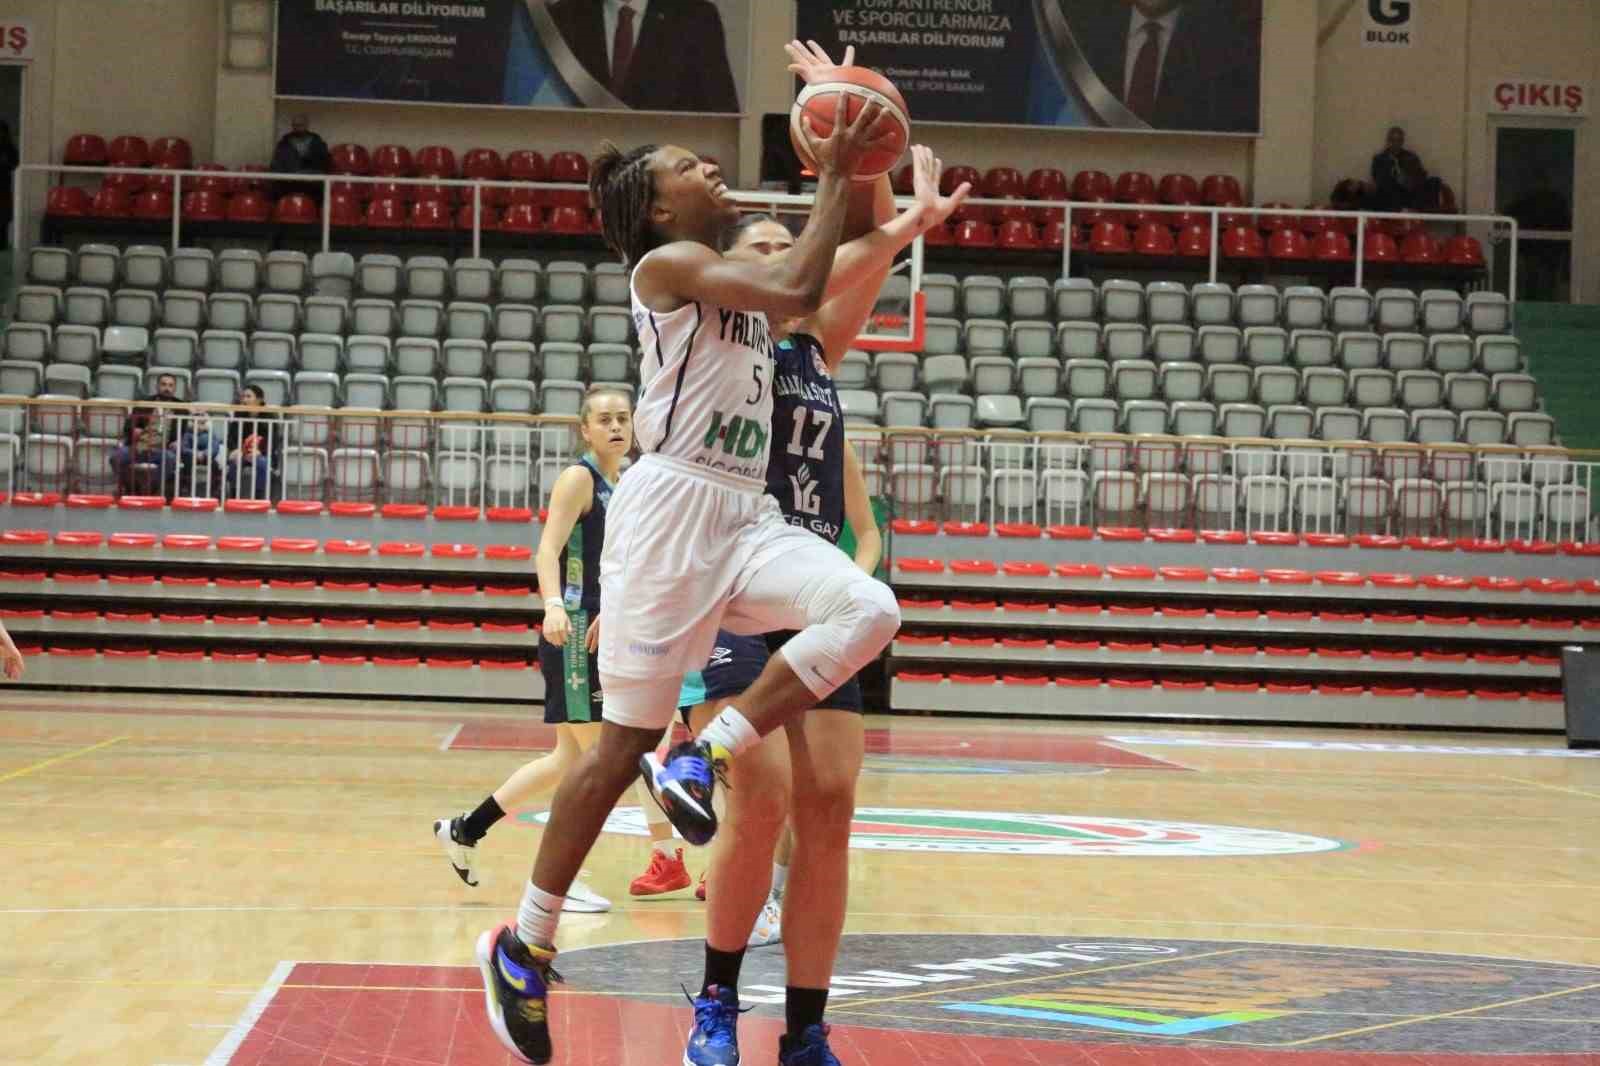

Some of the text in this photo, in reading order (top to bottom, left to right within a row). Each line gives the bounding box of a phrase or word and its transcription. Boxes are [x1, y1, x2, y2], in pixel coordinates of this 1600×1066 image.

[315, 0, 486, 18] BAŞARILAR DİLİYORUM
[832, 9, 1012, 31] VE SPORCULARIMIZA
[1368, 0, 1410, 26] G
[837, 30, 1006, 49] BAŞARILAR DİLİYORUM
[1366, 30, 1410, 44] BLOK
[1495, 83, 1583, 112] ÇIKIŞ
[744, 364, 763, 405] 5
[787, 406, 833, 461] 17
